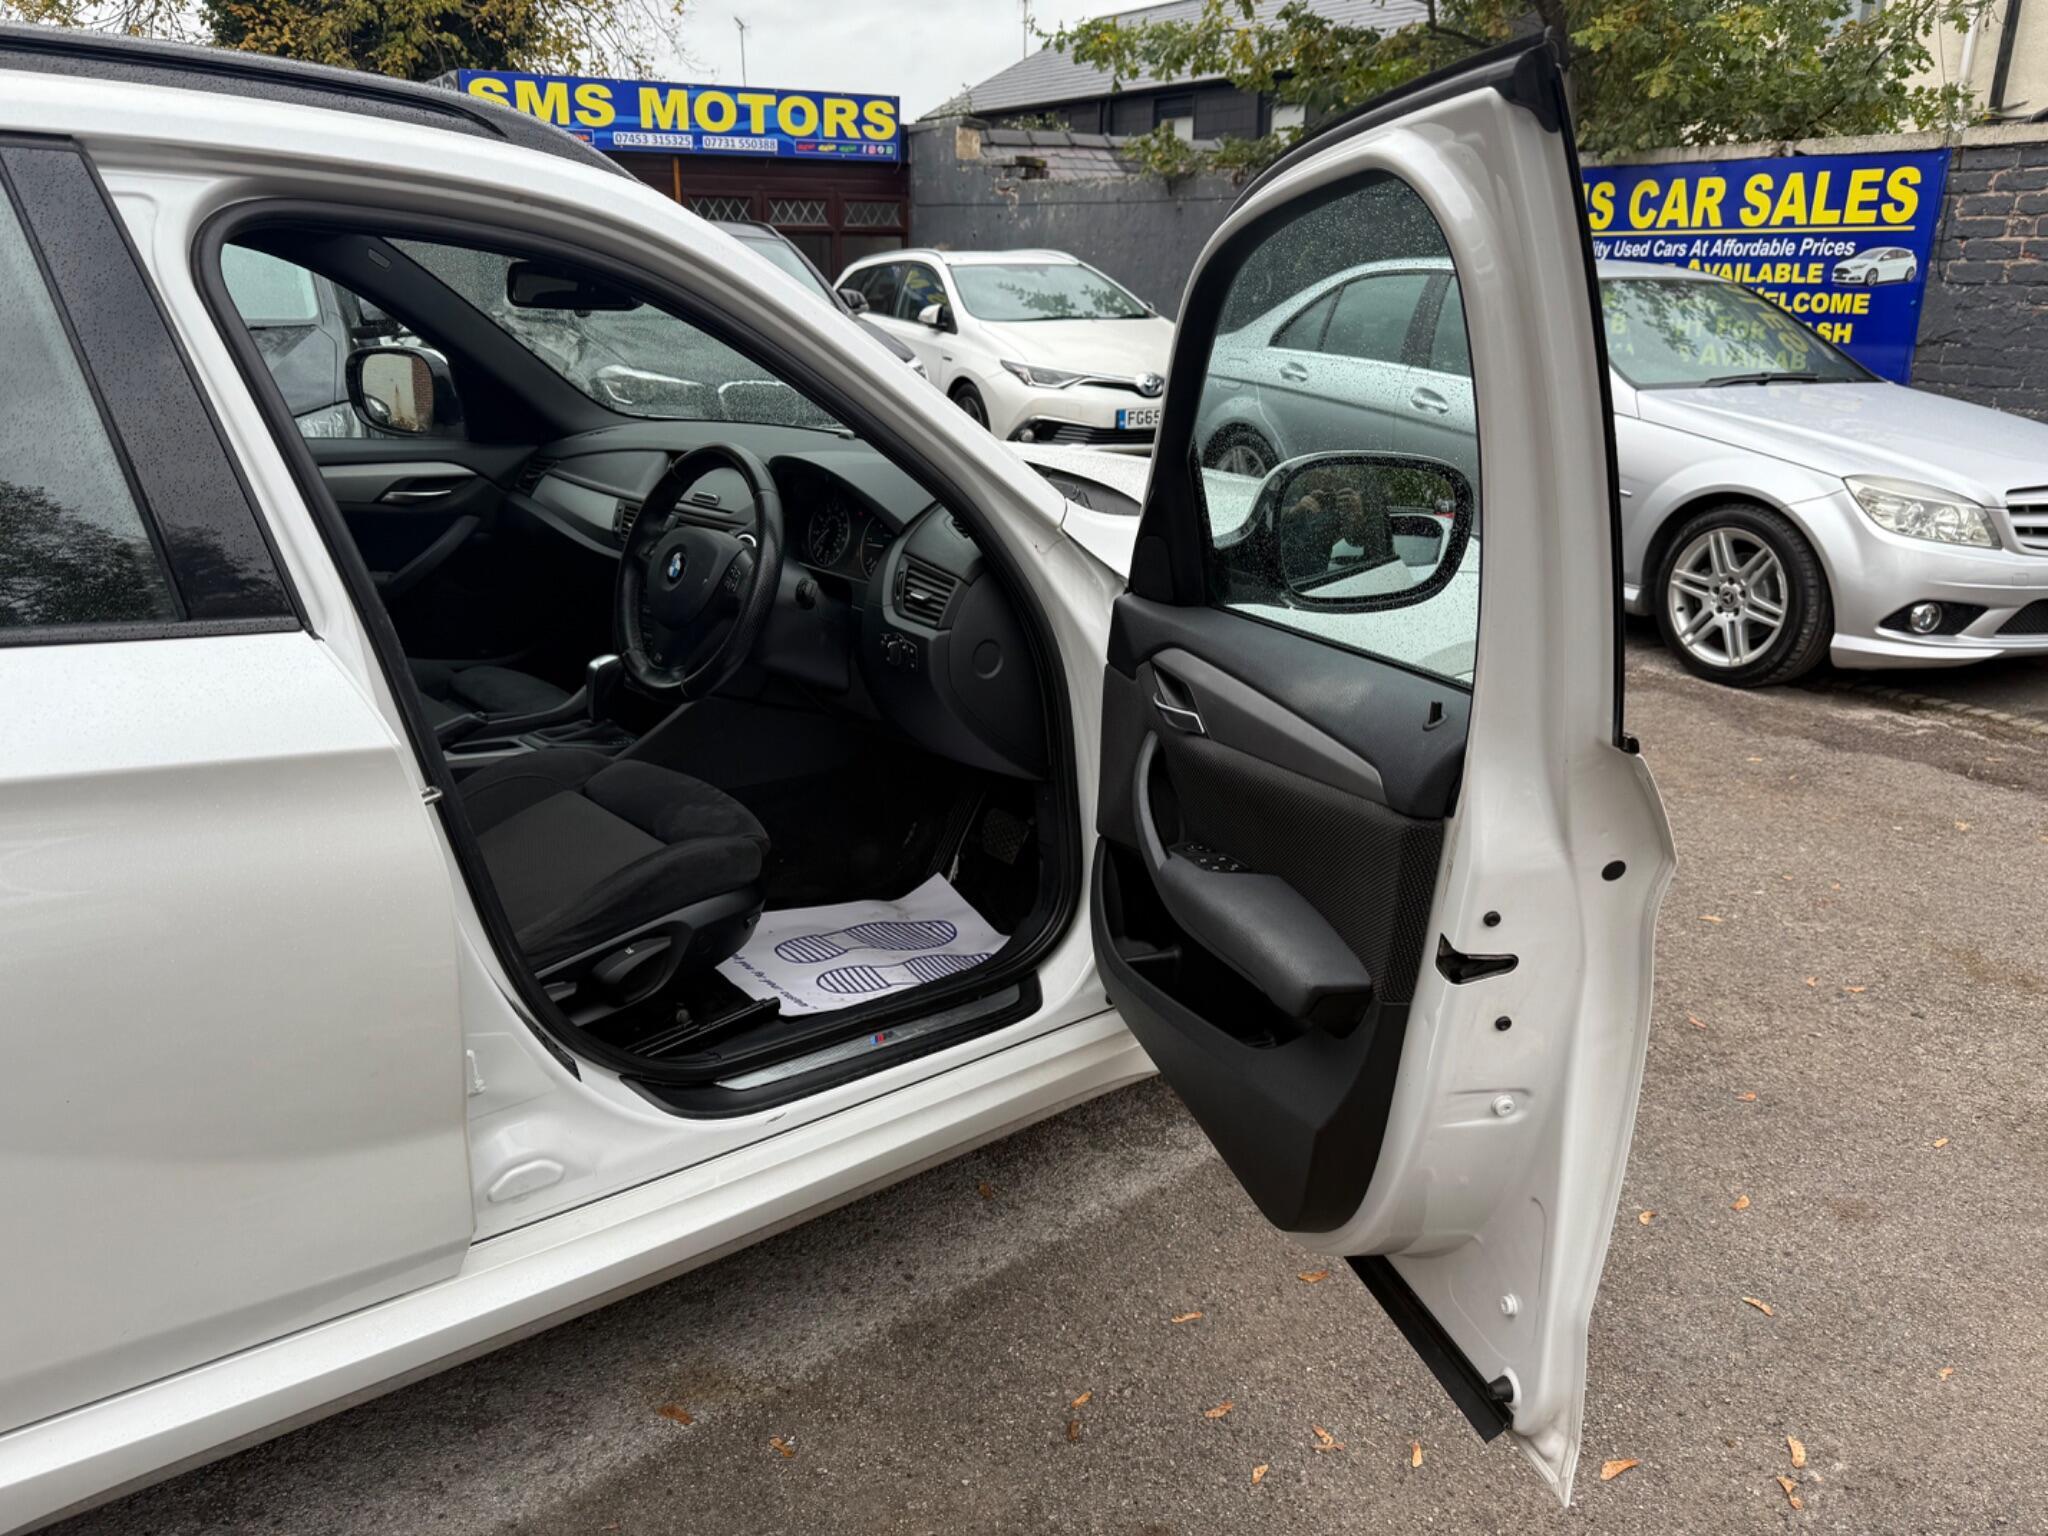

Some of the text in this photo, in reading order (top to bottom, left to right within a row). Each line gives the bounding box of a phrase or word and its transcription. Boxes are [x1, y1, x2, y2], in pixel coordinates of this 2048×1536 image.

[467, 77, 897, 140] SMS MOTORS
[614, 133, 691, 147] 07453 315325
[703, 136, 736, 148] 07731
[1583, 166, 1922, 230] S CAR SALES
[1613, 240, 1651, 257] Used
[1653, 239, 1688, 257] Cars
[1689, 239, 1709, 257] At
[1709, 238, 1796, 257] Affordable
[1800, 237, 1856, 256] Prices
[1751, 287, 1871, 315] ELCOME
